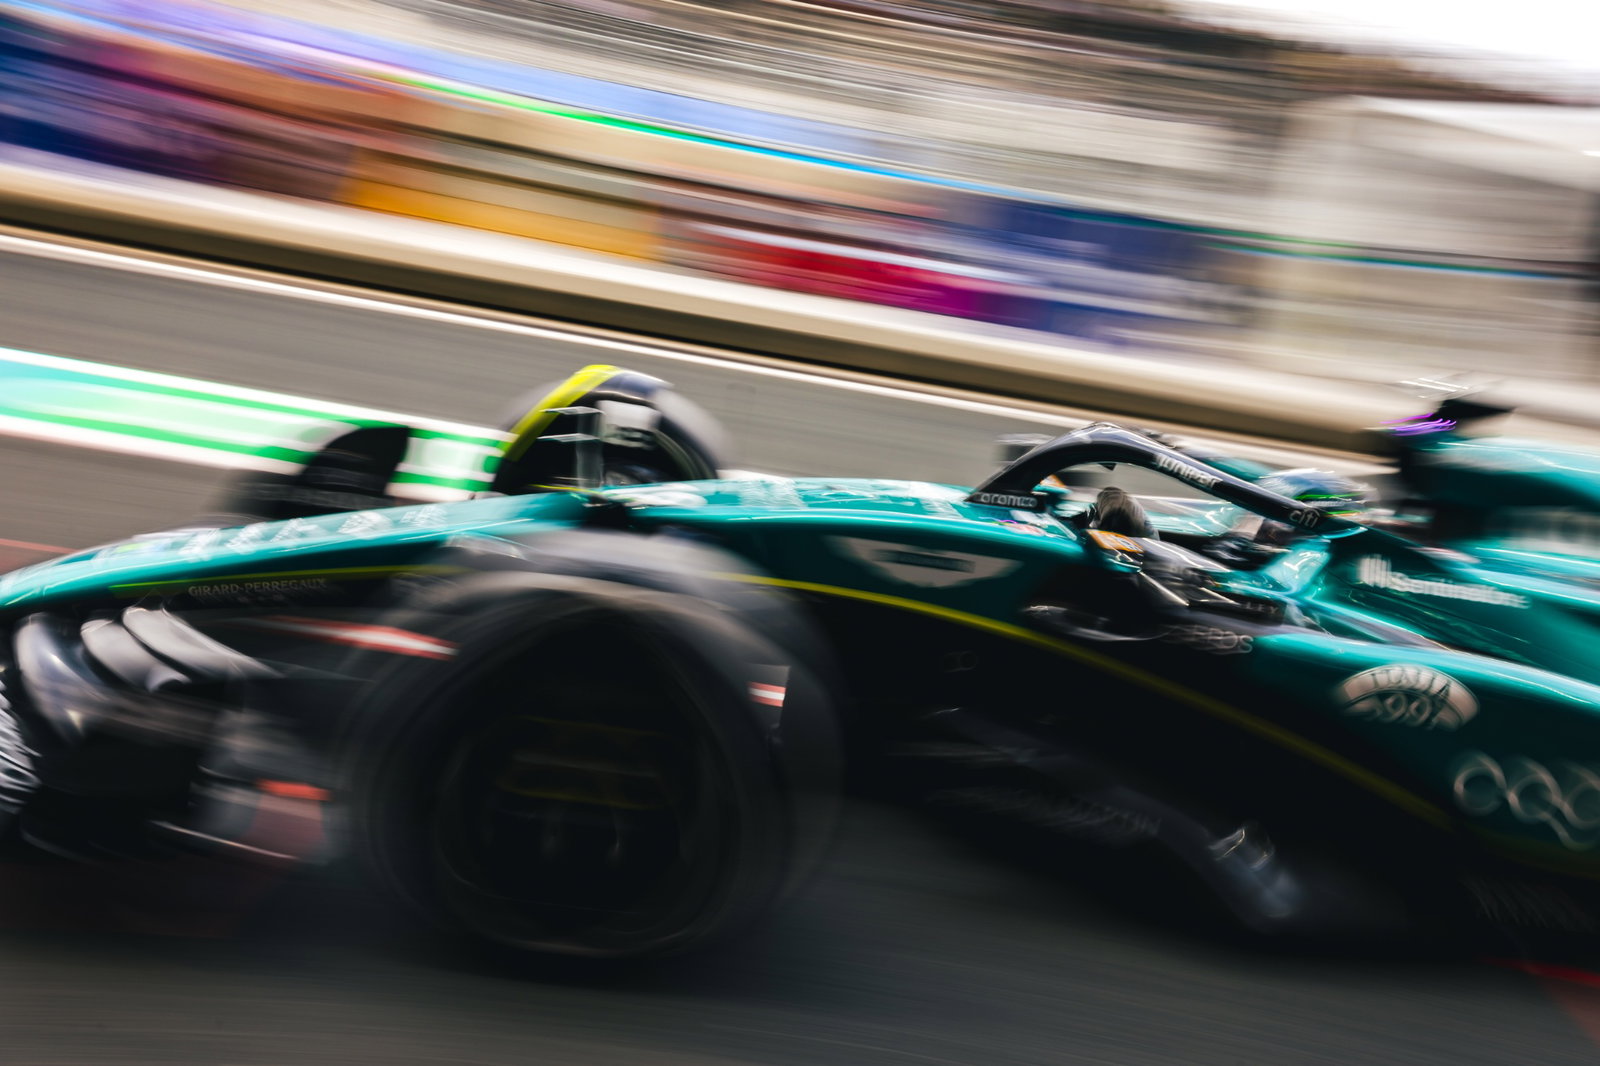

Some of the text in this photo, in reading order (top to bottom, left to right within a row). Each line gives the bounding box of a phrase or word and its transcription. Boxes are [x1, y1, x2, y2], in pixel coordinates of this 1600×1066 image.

[980, 493, 1038, 507] aramco
[1290, 508, 1320, 529] citi
[187, 578, 328, 598] GIRARD-PERREGAUX
